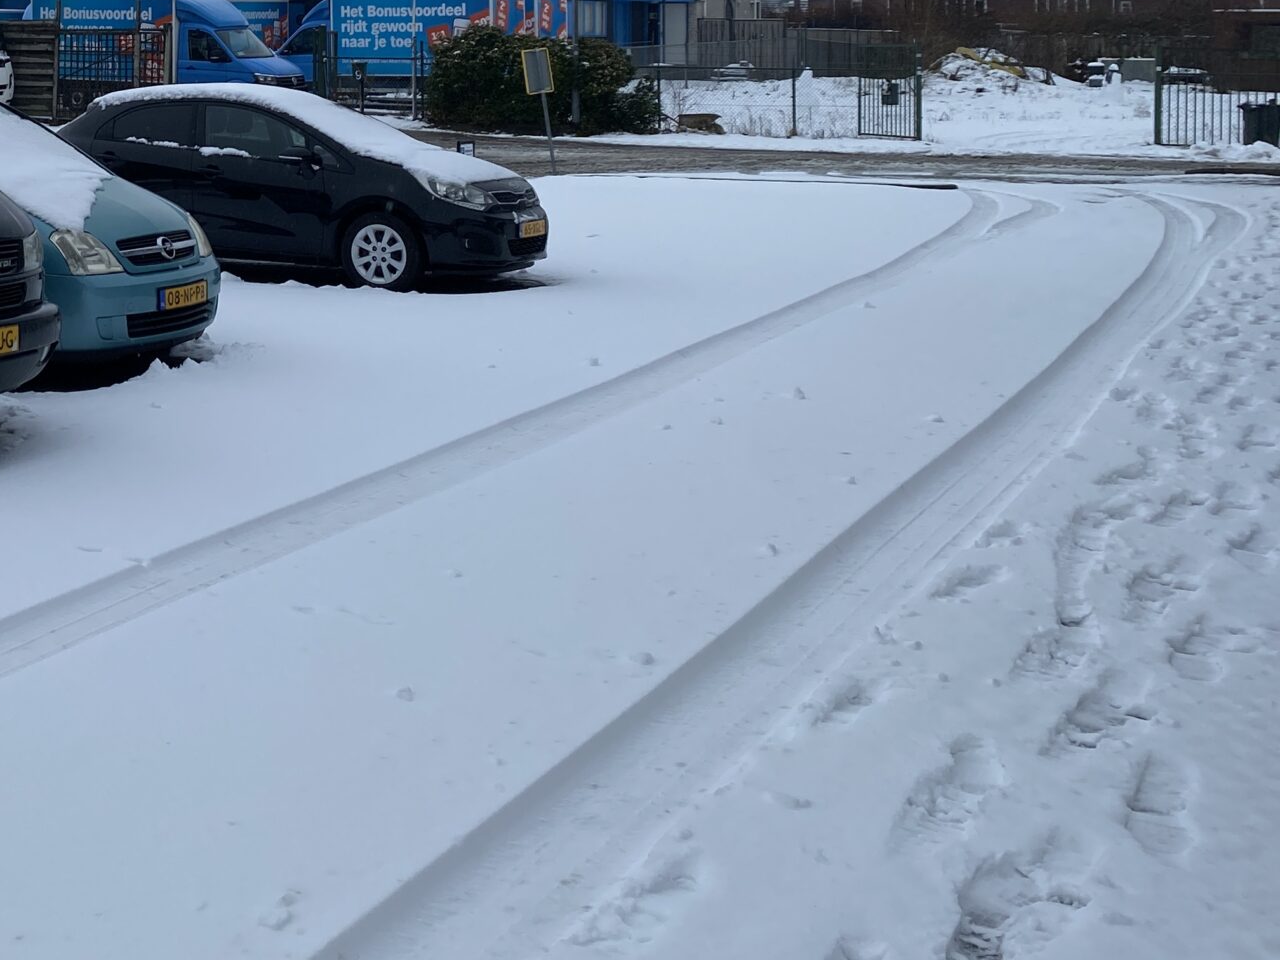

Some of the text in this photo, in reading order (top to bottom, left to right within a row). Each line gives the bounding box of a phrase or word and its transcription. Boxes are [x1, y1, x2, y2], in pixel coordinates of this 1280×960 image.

[40, 6, 59, 19] He
[340, 2, 467, 18] Het Bonusvoordeel
[341, 20, 424, 36] rijdt gewoon
[341, 37, 372, 48] naar
[373, 34, 387, 51] je
[354, 70, 362, 80] 9
